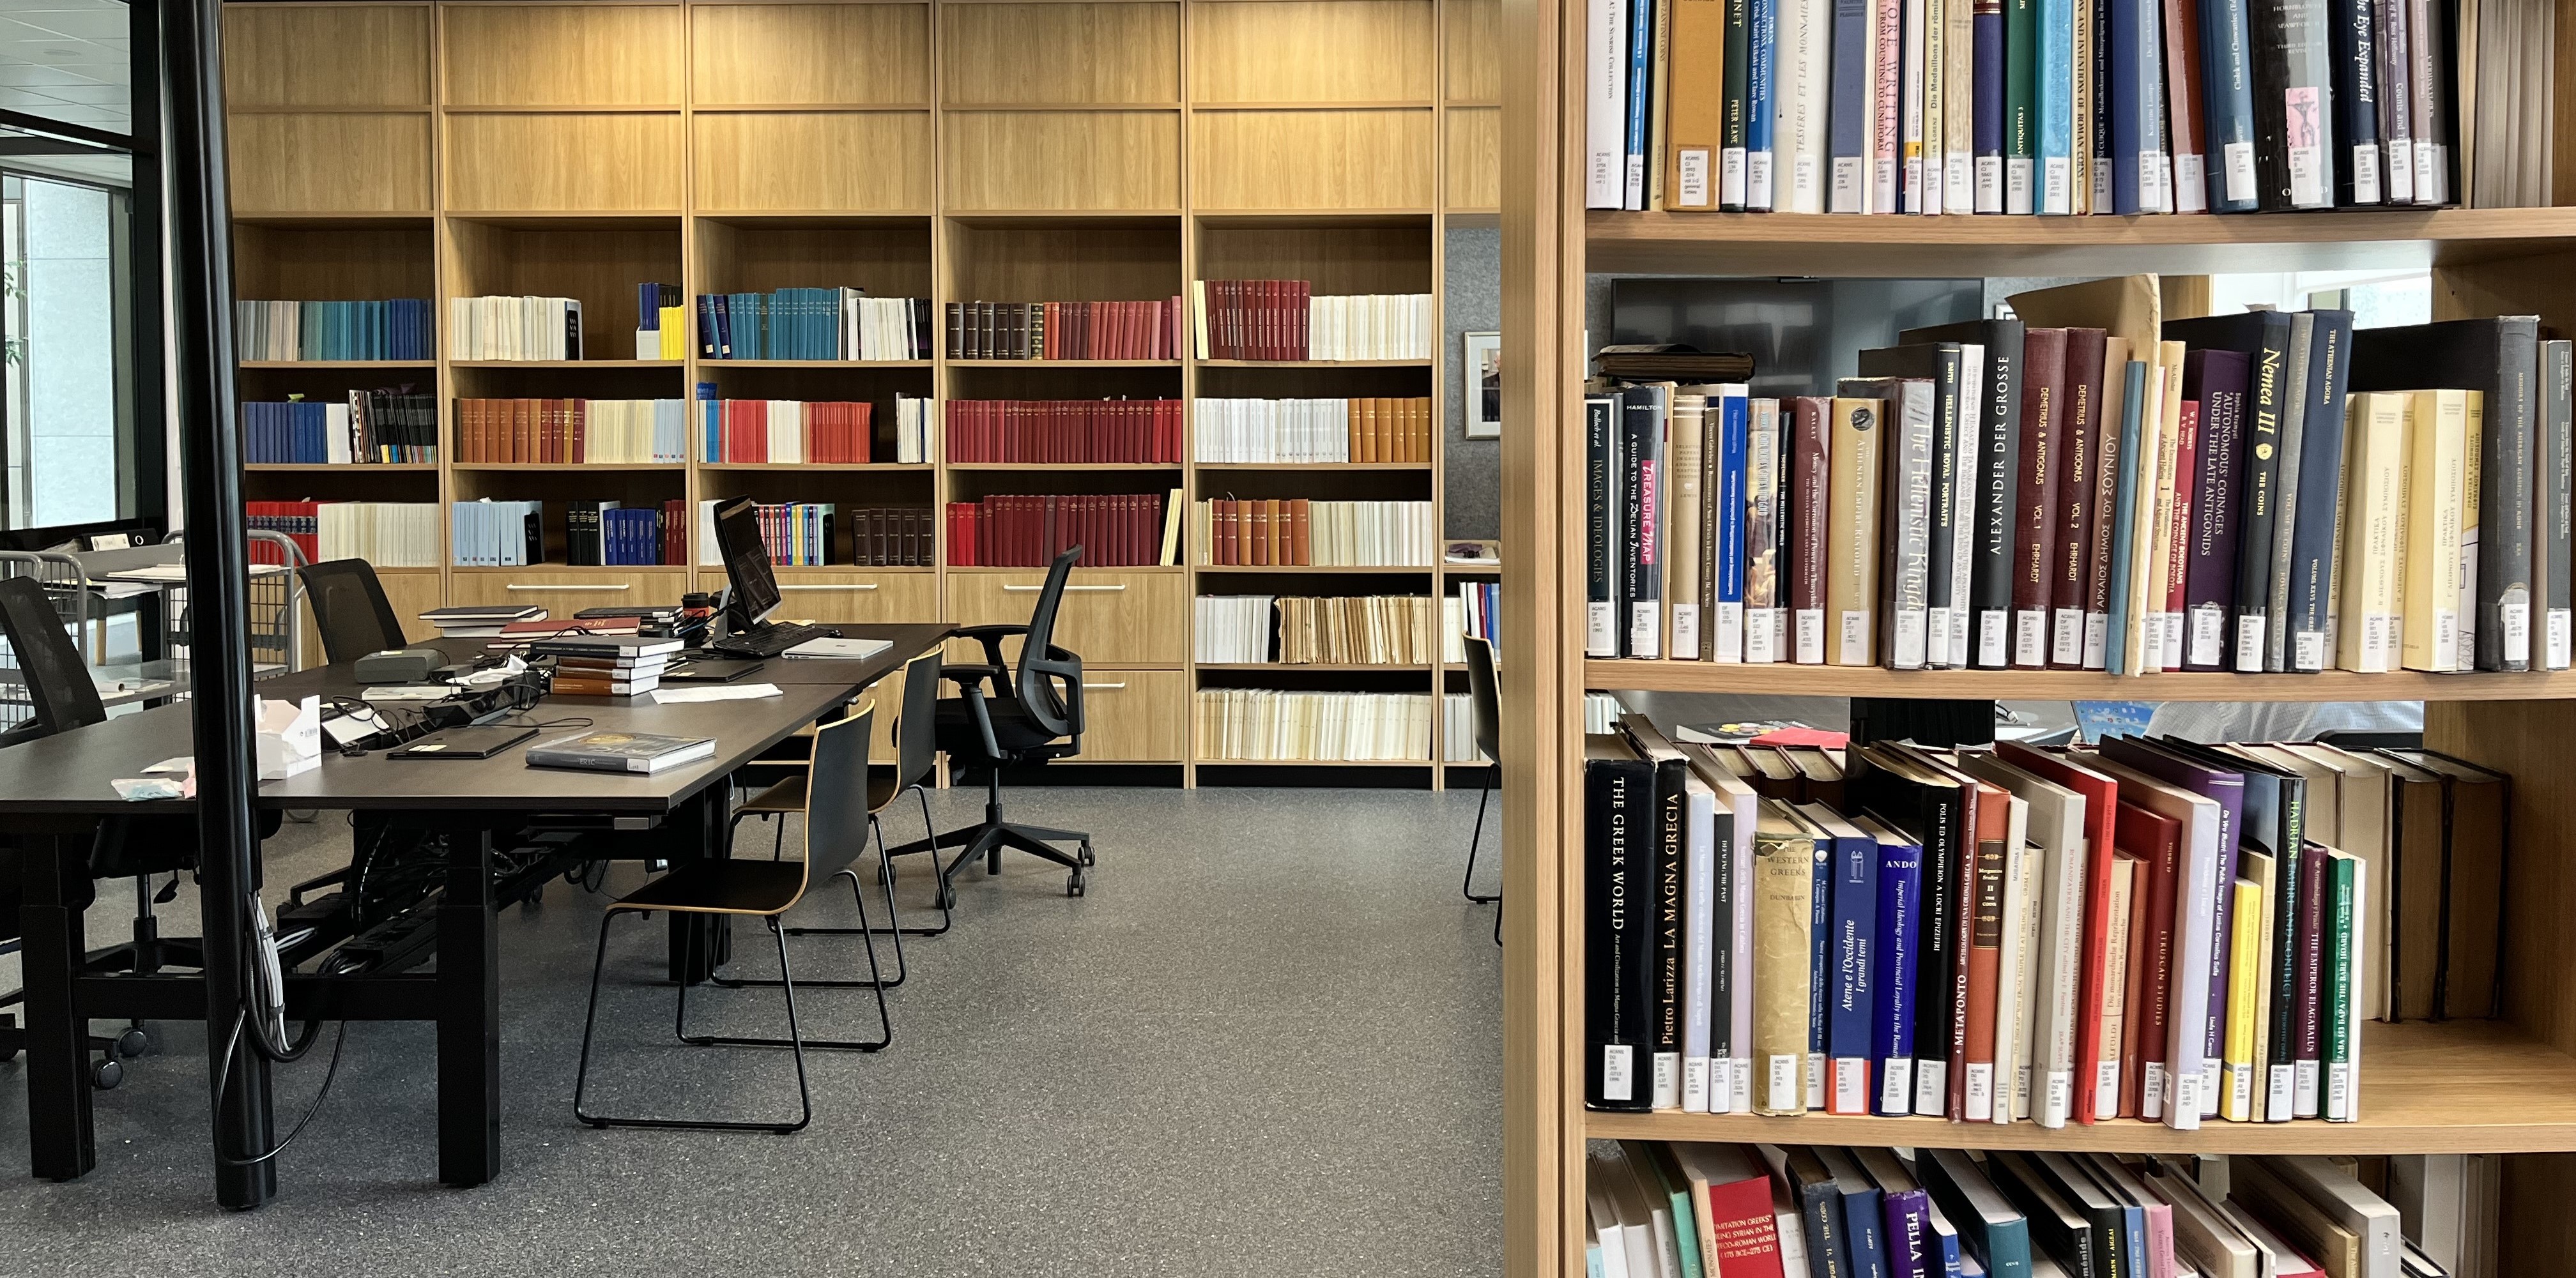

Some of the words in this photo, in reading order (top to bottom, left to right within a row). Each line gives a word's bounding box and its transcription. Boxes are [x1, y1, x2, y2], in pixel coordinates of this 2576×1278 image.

[1887, 1, 1897, 47] ORE
[2358, 0, 2370, 11] he
[2356, 16, 2370, 36] Eye
[2356, 41, 2372, 102] Expanded
[1879, 87, 1884, 98] TO
[1885, 61, 1896, 152] WRITING
[2260, 348, 2280, 405] Nemea
[2326, 345, 2335, 379] ATHENIAN
[1996, 356, 2009, 416] GROSSE
[2076, 384, 2087, 424] DEMETRIUS
[2232, 393, 2240, 412] Sophia
[2324, 381, 2333, 404] AGORA
[1944, 395, 1952, 449] HELLENISTIC
[2037, 388, 2049, 427] DEMETRIUS
[2210, 392, 2221, 429] UNDER
[2231, 415, 2239, 439] Kremydi
[2258, 411, 2275, 434] III
[1912, 420, 1930, 451] The
[1995, 422, 2007, 453] DER
[2209, 433, 2218, 454] THE
[1630, 471, 1637, 481] TO
[1856, 440, 1865, 487] ATHENIAN
[2035, 441, 2046, 485] ANTIGONUS
[2073, 438, 2084, 482] ANTIGONUS
[2102, 434, 2116, 496] ΣΟΥΝΙΟΥ
[2206, 457, 2216, 484] LATE
[1593, 460, 1602, 500] IMAGES
[1642, 464, 1653, 527] TREASURE
[1855, 491, 1864, 525] EMPIRE
[1908, 459, 1929, 546] Hellenistic
[1941, 483, 1949, 527] PORTRAITS
[1991, 460, 2007, 555] ALEXANDER
[2102, 499, 2112, 519] ΤΟΥ
[2201, 487, 2214, 556] ANTIGONIDS
[2216, 480, 2227, 535] COINAGES
[2257, 491, 2265, 515] COINS
[1593, 516, 1602, 582] IDEOLOGIES
[1642, 531, 1652, 561] MAP
[2101, 524, 2110, 563] ΔΗΜΟΣ
[2178, 515, 2186, 544] ANCIENT
[1854, 529, 1863, 576] RESTORED
[2030, 544, 2041, 582] EHRHARDT
[2068, 542, 2079, 581] EHRHARDT
[2177, 545, 2185, 584] BOEOTIANS
[2097, 565, 2107, 608] ΑΡΧΑΙΟΣ
[1613, 777, 1624, 809] THE
[1613, 814, 1624, 865] GREEK
[1666, 795, 1678, 855] GRECIA
[1938, 827, 1945, 835] ED
[2288, 801, 2300, 858] HADRIAN
[1767, 856, 1809, 865] WESTERN
[1936, 839, 1945, 883] OLYMPIEION
[1613, 871, 1624, 929] WORLD
[1665, 862, 1676, 921] MAGNA
[1895, 880, 1905, 908] Imperial
[2216, 886, 2225, 903] Image
[2287, 863, 2297, 903] EMPIRE
[1894, 909, 1904, 936] Ideology
[2110, 892, 2122, 943] Repräsentation
[2286, 910, 2295, 937] AND
[1664, 928, 1675, 949] LA
[1857, 939, 1866, 957] temi
[2158, 931, 2167, 980] ETRUSCAN
[1663, 958, 1675, 1003] Larizza
[1857, 959, 1867, 987] grandi
[2108, 947, 2117, 993] monarchische
[2283, 940, 2294, 999] CONFLICT
[1842, 983, 1853, 1011] Atene
[1892, 987, 1901, 1012] Loyalty
[1955, 975, 1966, 1046] METAPONTO
[2156, 985, 2164, 1026] STUDIES
[1662, 1007, 1674, 1044] Pietro
[2308, 996, 2316, 1052] ELAGABALUS
[1733, 1229, 1754, 1238] SYRIAN
[1763, 1224, 1774, 1233] THE
[1820, 1201, 1828, 1222] COINS
[1822, 1225, 1831, 1240] THE
[1906, 1212, 1922, 1261] PELLA
